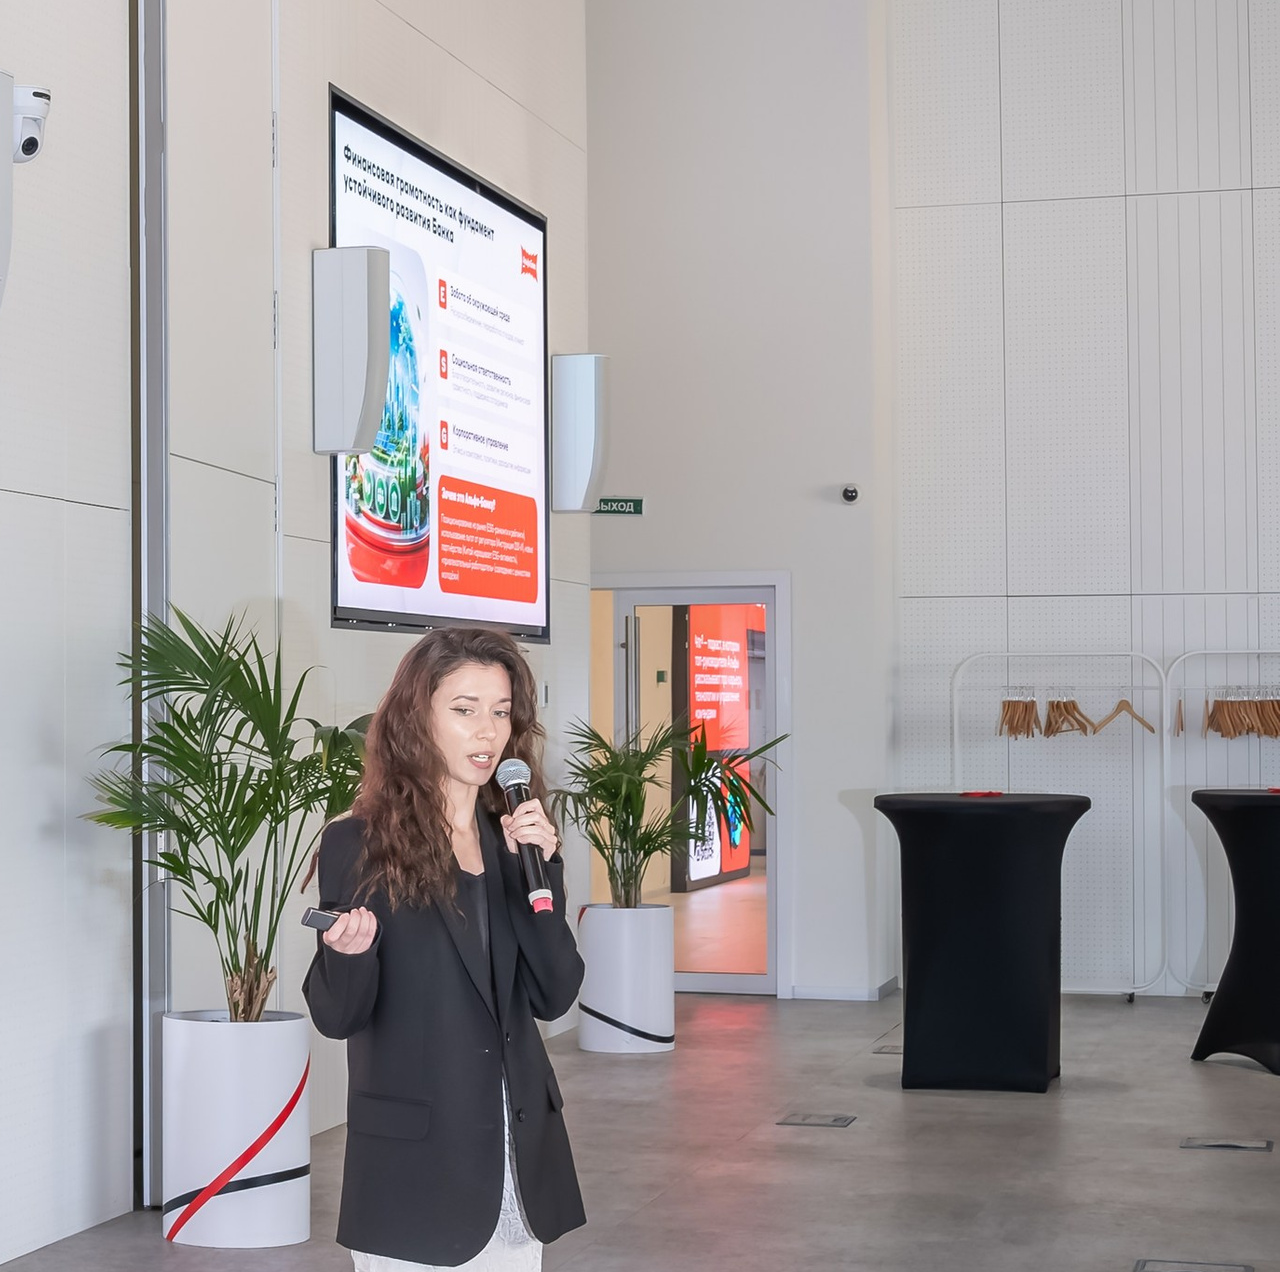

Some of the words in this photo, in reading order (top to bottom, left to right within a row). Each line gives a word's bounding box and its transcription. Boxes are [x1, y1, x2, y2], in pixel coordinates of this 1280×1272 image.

[343, 143, 395, 187] Финансовая
[396, 176, 443, 213] грамотность
[445, 203, 457, 221] как
[458, 205, 495, 242] фундамент
[343, 174, 394, 213] устойчивого
[395, 202, 431, 231] развития
[432, 217, 454, 243] Банка
[596, 500, 634, 513] ЫХОД
